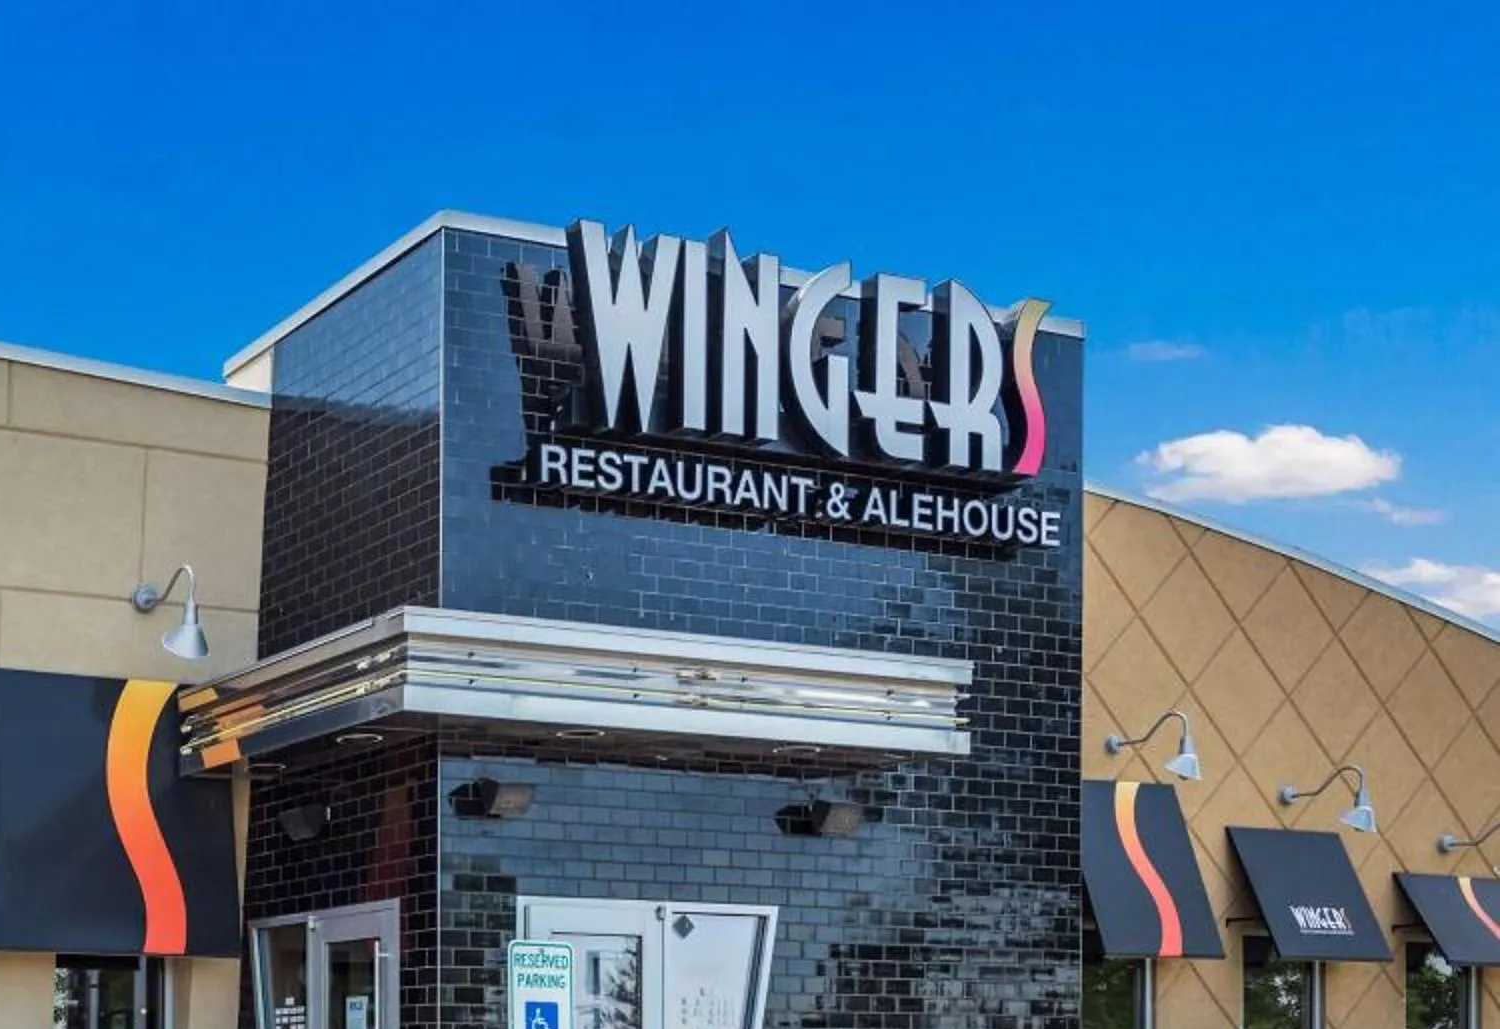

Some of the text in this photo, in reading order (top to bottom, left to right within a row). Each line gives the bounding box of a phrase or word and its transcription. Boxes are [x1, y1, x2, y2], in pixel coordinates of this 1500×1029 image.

[569, 218, 1052, 475] WINGERS
[540, 443, 1061, 548] RESTAURANT & ALEHOUSE
[513, 951, 568, 970] RESERVED
[517, 972, 566, 989] PARKING
